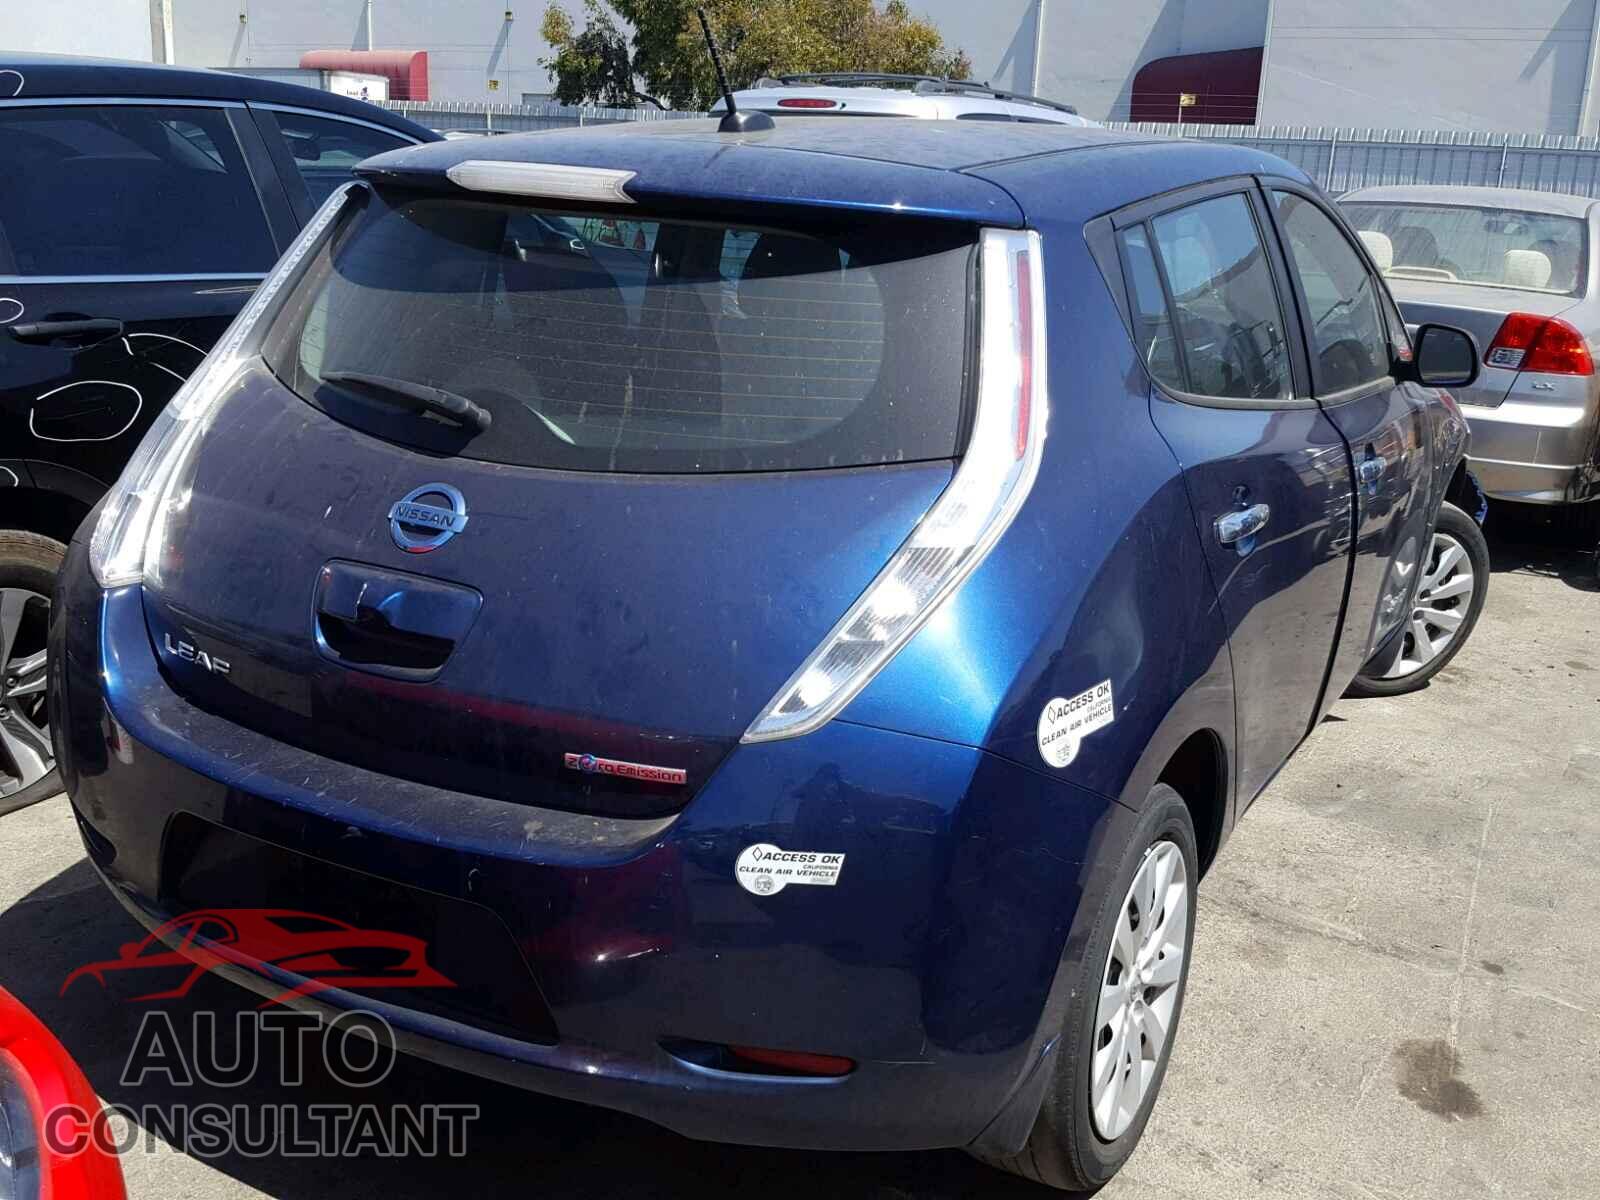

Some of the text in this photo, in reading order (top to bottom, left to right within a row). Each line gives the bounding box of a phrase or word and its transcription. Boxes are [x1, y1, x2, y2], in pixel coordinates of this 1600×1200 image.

[396, 503, 456, 528] NISSAN
[164, 632, 231, 675] LEAF
[1056, 682, 1110, 720] ACCESS OK
[1041, 703, 1112, 746] CLEAN AIR VEHICLE
[616, 764, 682, 782] Emission
[763, 852, 841, 864] ACCESS OK
[739, 865, 773, 874] CLEAN
[797, 869, 837, 877] VEHICLE
